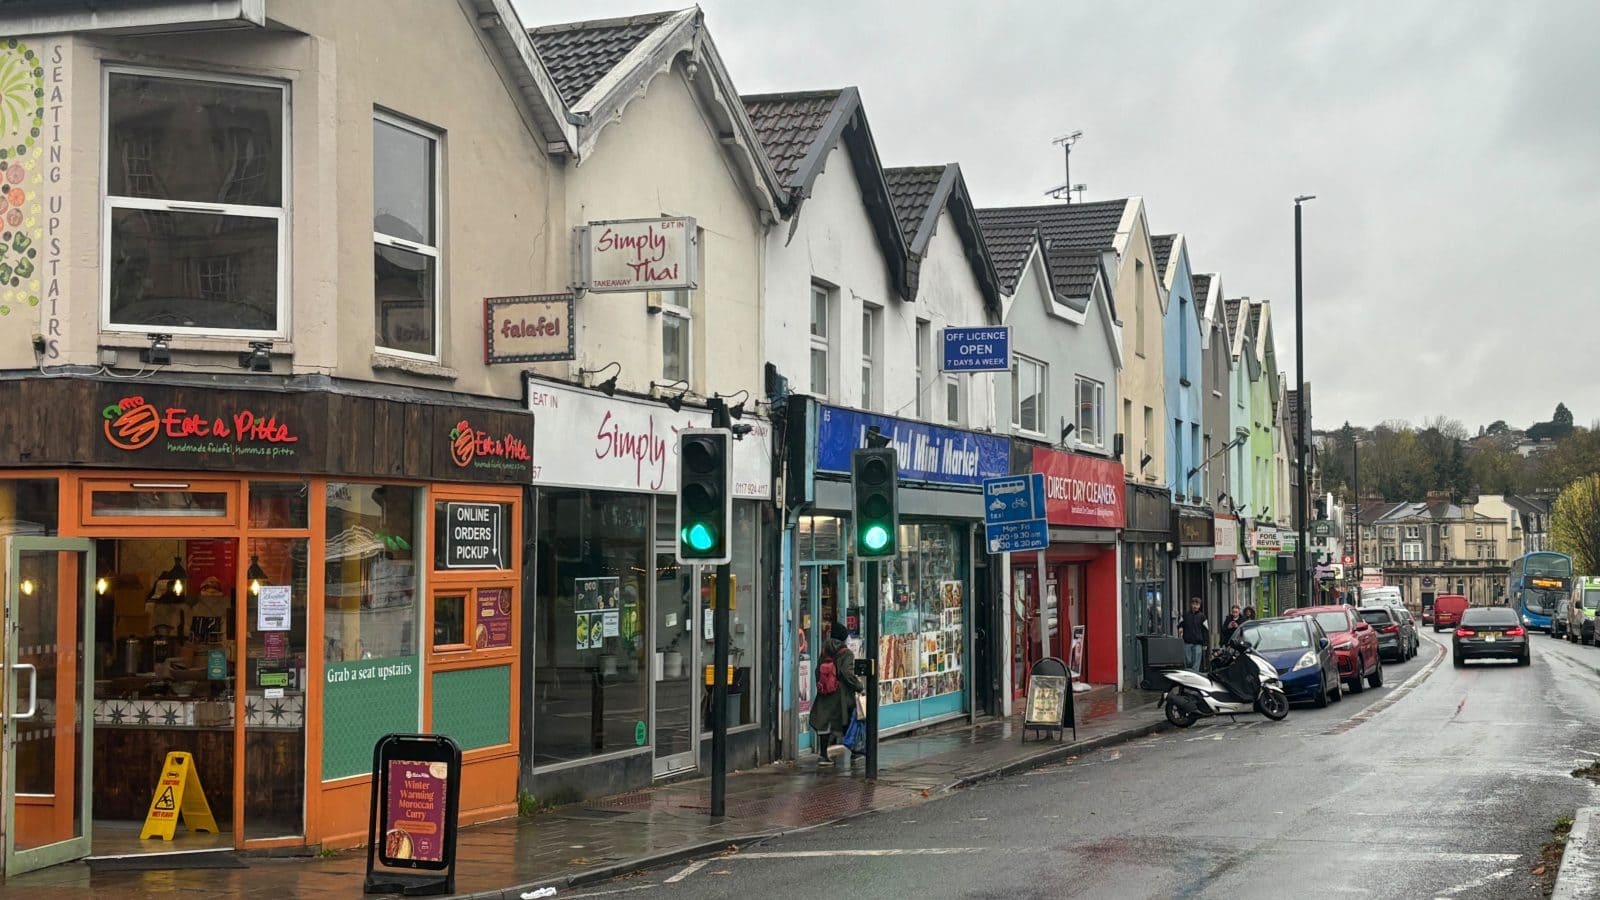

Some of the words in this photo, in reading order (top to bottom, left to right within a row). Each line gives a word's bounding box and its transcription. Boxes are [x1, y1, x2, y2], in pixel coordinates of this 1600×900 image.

[50, 44, 63, 183] SEATING
[677, 221, 685, 229] IN
[597, 225, 666, 262] Simply
[48, 195, 62, 359] UPSTAIRS
[626, 258, 678, 282] Thai
[593, 278, 632, 287] TAKEAWAY
[501, 316, 560, 339] falafel
[946, 333, 965, 342] OFF
[966, 331, 1006, 341] LICENCE
[960, 344, 993, 355] OPEN
[533, 392, 549, 407] EAT
[549, 396, 558, 409] IN
[162, 407, 209, 437] Eat
[213, 417, 230, 438] a
[233, 410, 298, 442] Pitta
[167, 442, 206, 452] handmade
[235, 445, 265, 455] hummus
[272, 447, 295, 459] pitta
[474, 430, 495, 456] Eat
[496, 440, 504, 456] a
[504, 433, 531, 460] Pitta
[595, 410, 666, 490] Simply
[913, 433, 940, 473] Mini
[942, 438, 980, 477] Market
[1047, 475, 1072, 500] DIRECT
[1072, 479, 1086, 502] DRY
[1086, 481, 1116, 505] CLEANERS
[457, 507, 490, 522] ONLINE
[454, 526, 492, 541] ORDERS
[456, 545, 489, 559] PICKUP
[1031, 540, 1042, 548] pm
[327, 667, 350, 683] Grab
[351, 669, 357, 680] a
[358, 666, 376, 680] seat
[377, 662, 412, 681] upstairs
[404, 780, 430, 790] Winter
[400, 789, 435, 802] Warming
[398, 799, 434, 810] Moroccan
[405, 808, 426, 822] Curry
